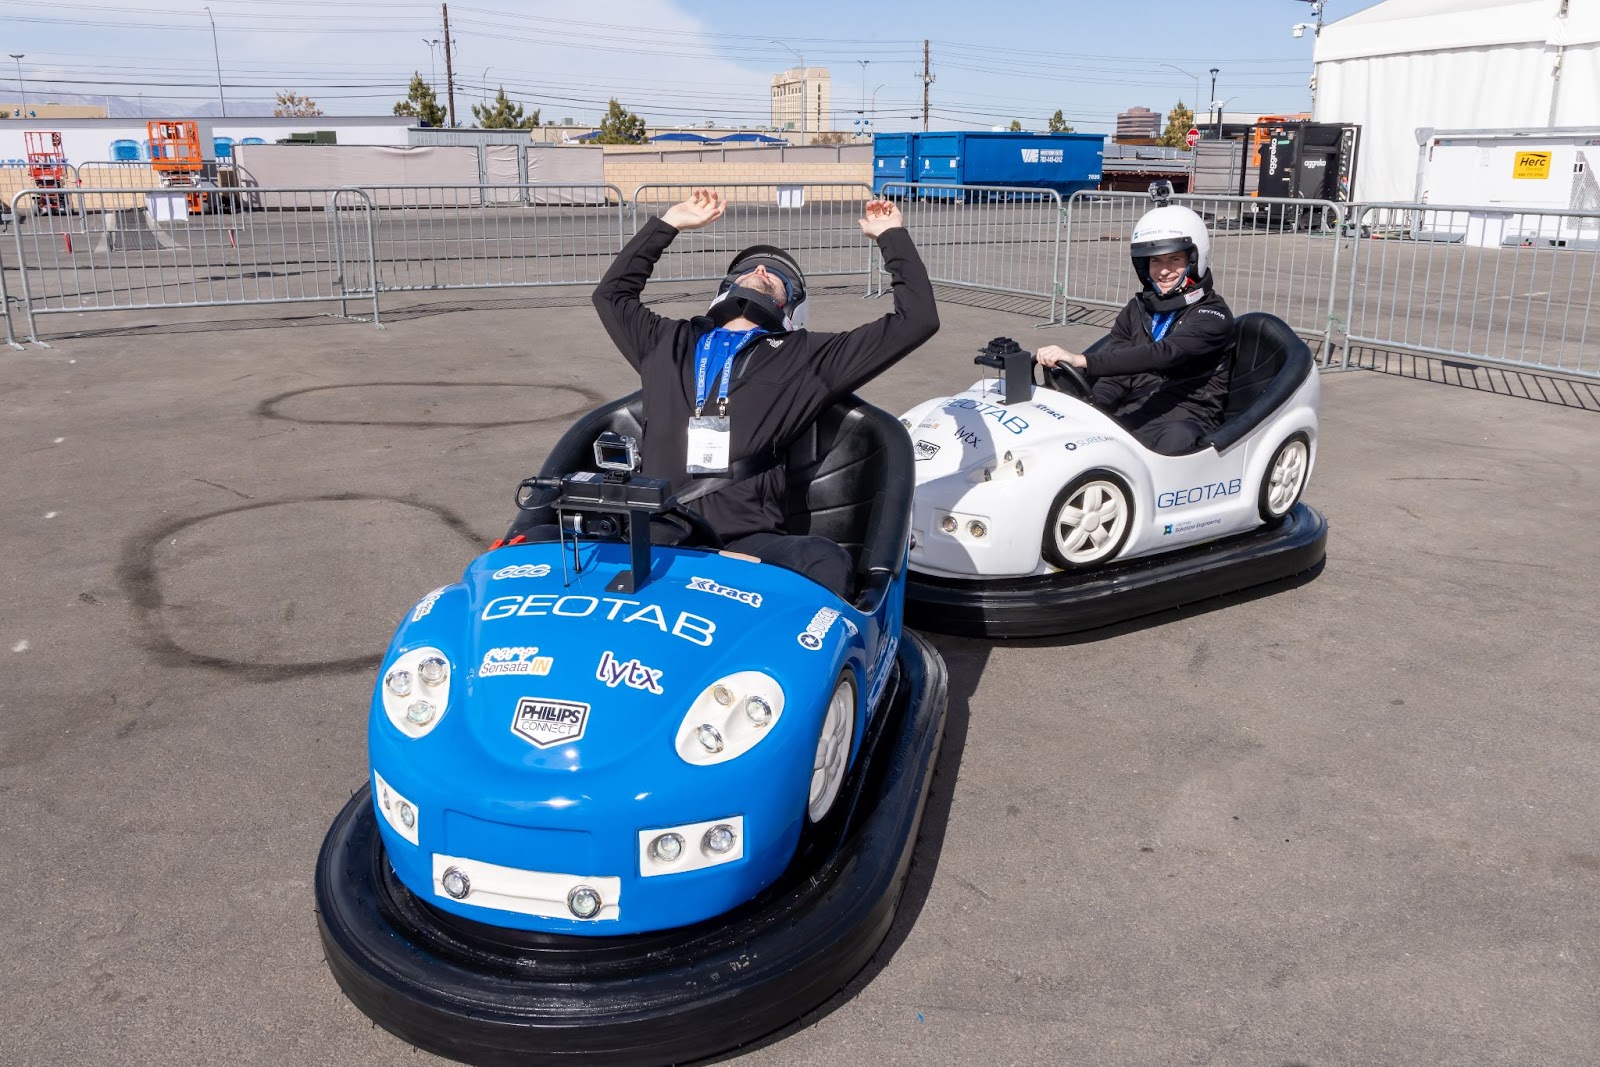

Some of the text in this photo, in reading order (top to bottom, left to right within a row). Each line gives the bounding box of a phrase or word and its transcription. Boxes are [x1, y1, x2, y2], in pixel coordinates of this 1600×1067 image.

[1269, 138, 1278, 175] aggreko
[1304, 159, 1326, 168] aggreko
[1520, 157, 1546, 166] Herc
[954, 426, 981, 448] lytx
[1158, 479, 1241, 508] GEOTAB
[687, 579, 760, 605] Xtract
[482, 595, 716, 646] GEOTAB
[481, 659, 550, 674] Sensata IN
[600, 654, 660, 690] lytx
[522, 705, 580, 723] PHILLIPS
[522, 722, 576, 735] CONNECT
